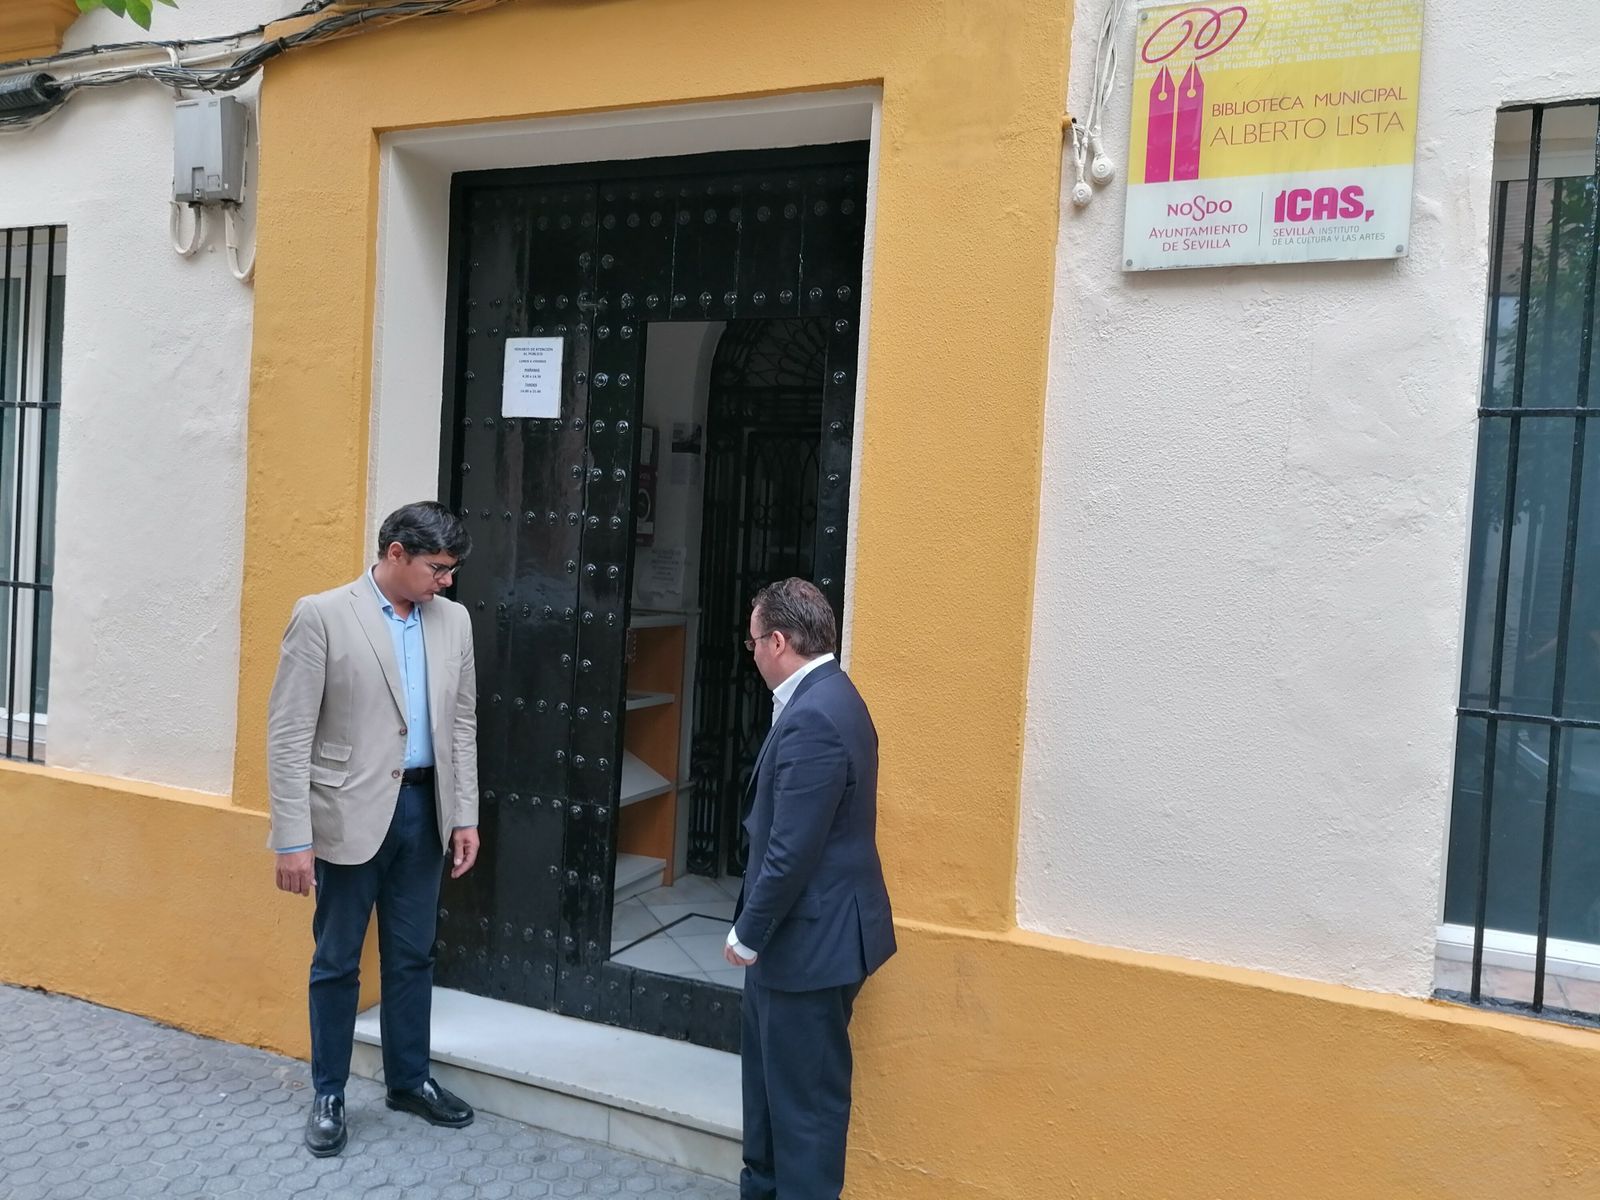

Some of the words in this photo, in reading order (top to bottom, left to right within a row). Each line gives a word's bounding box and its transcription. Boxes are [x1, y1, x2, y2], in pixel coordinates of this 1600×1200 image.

[1212, 96, 1304, 117] BIBLIOTECA
[1314, 87, 1408, 108] MUNICIPAL
[1210, 118, 1326, 147] ALBERTO
[1337, 112, 1405, 136] LISTA
[1149, 224, 1248, 239] AYUNTAMIENTO
[1273, 227, 1315, 237] SEVILLA
[1319, 225, 1360, 235] INSTITUTO
[1162, 242, 1178, 252] DE
[1183, 238, 1231, 251] SEVILLA
[1272, 238, 1283, 246] DE
[1285, 237, 1294, 245] LA
[1296, 235, 1332, 245] CULTURA
[1342, 234, 1357, 242] LAS
[1359, 232, 1386, 241] ARTES
